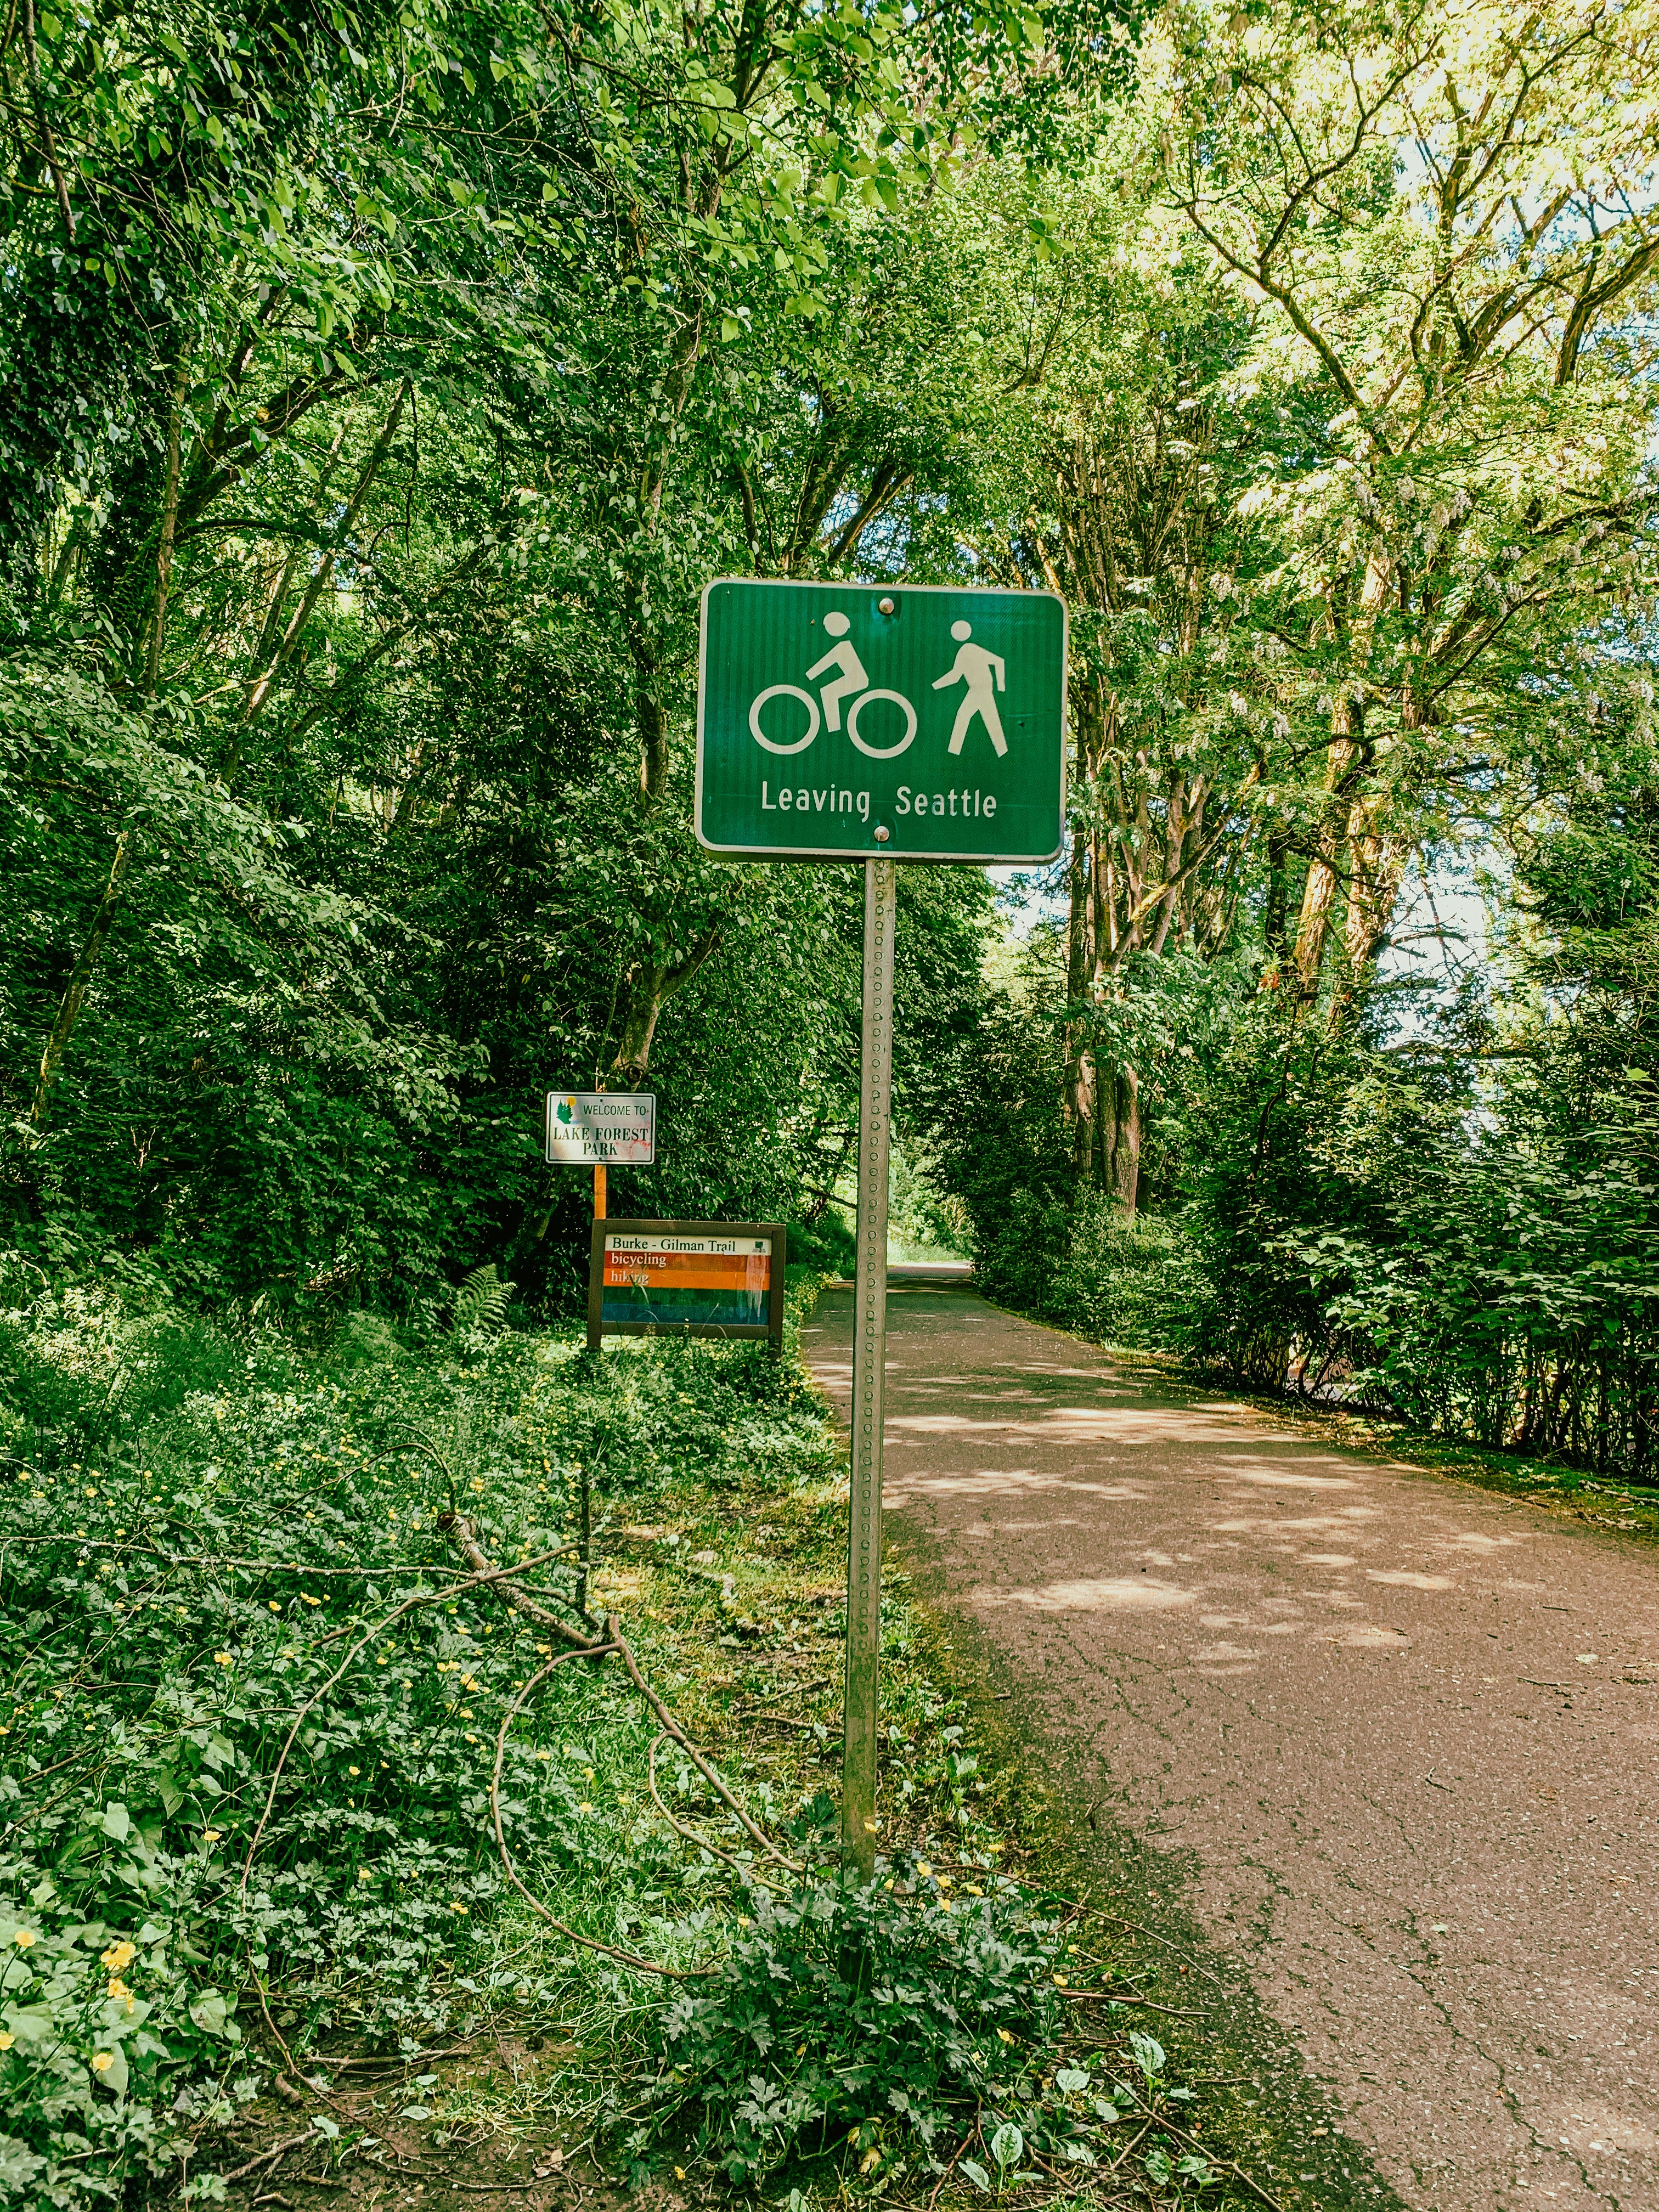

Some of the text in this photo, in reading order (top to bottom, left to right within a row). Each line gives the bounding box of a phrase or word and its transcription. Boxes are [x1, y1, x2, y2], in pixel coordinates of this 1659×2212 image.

[761, 781, 997, 823] Leaving Seattle
[584, 1105, 646, 1116] WELCOME TO
[553, 1127, 648, 1141] LAKE FOREST
[583, 1142, 618, 1155] PARK
[612, 1237, 648, 1249] Burke
[661, 1239, 704, 1251] Gilman
[708, 1240, 735, 1252] Trail
[611, 1252, 667, 1267] bicycling
